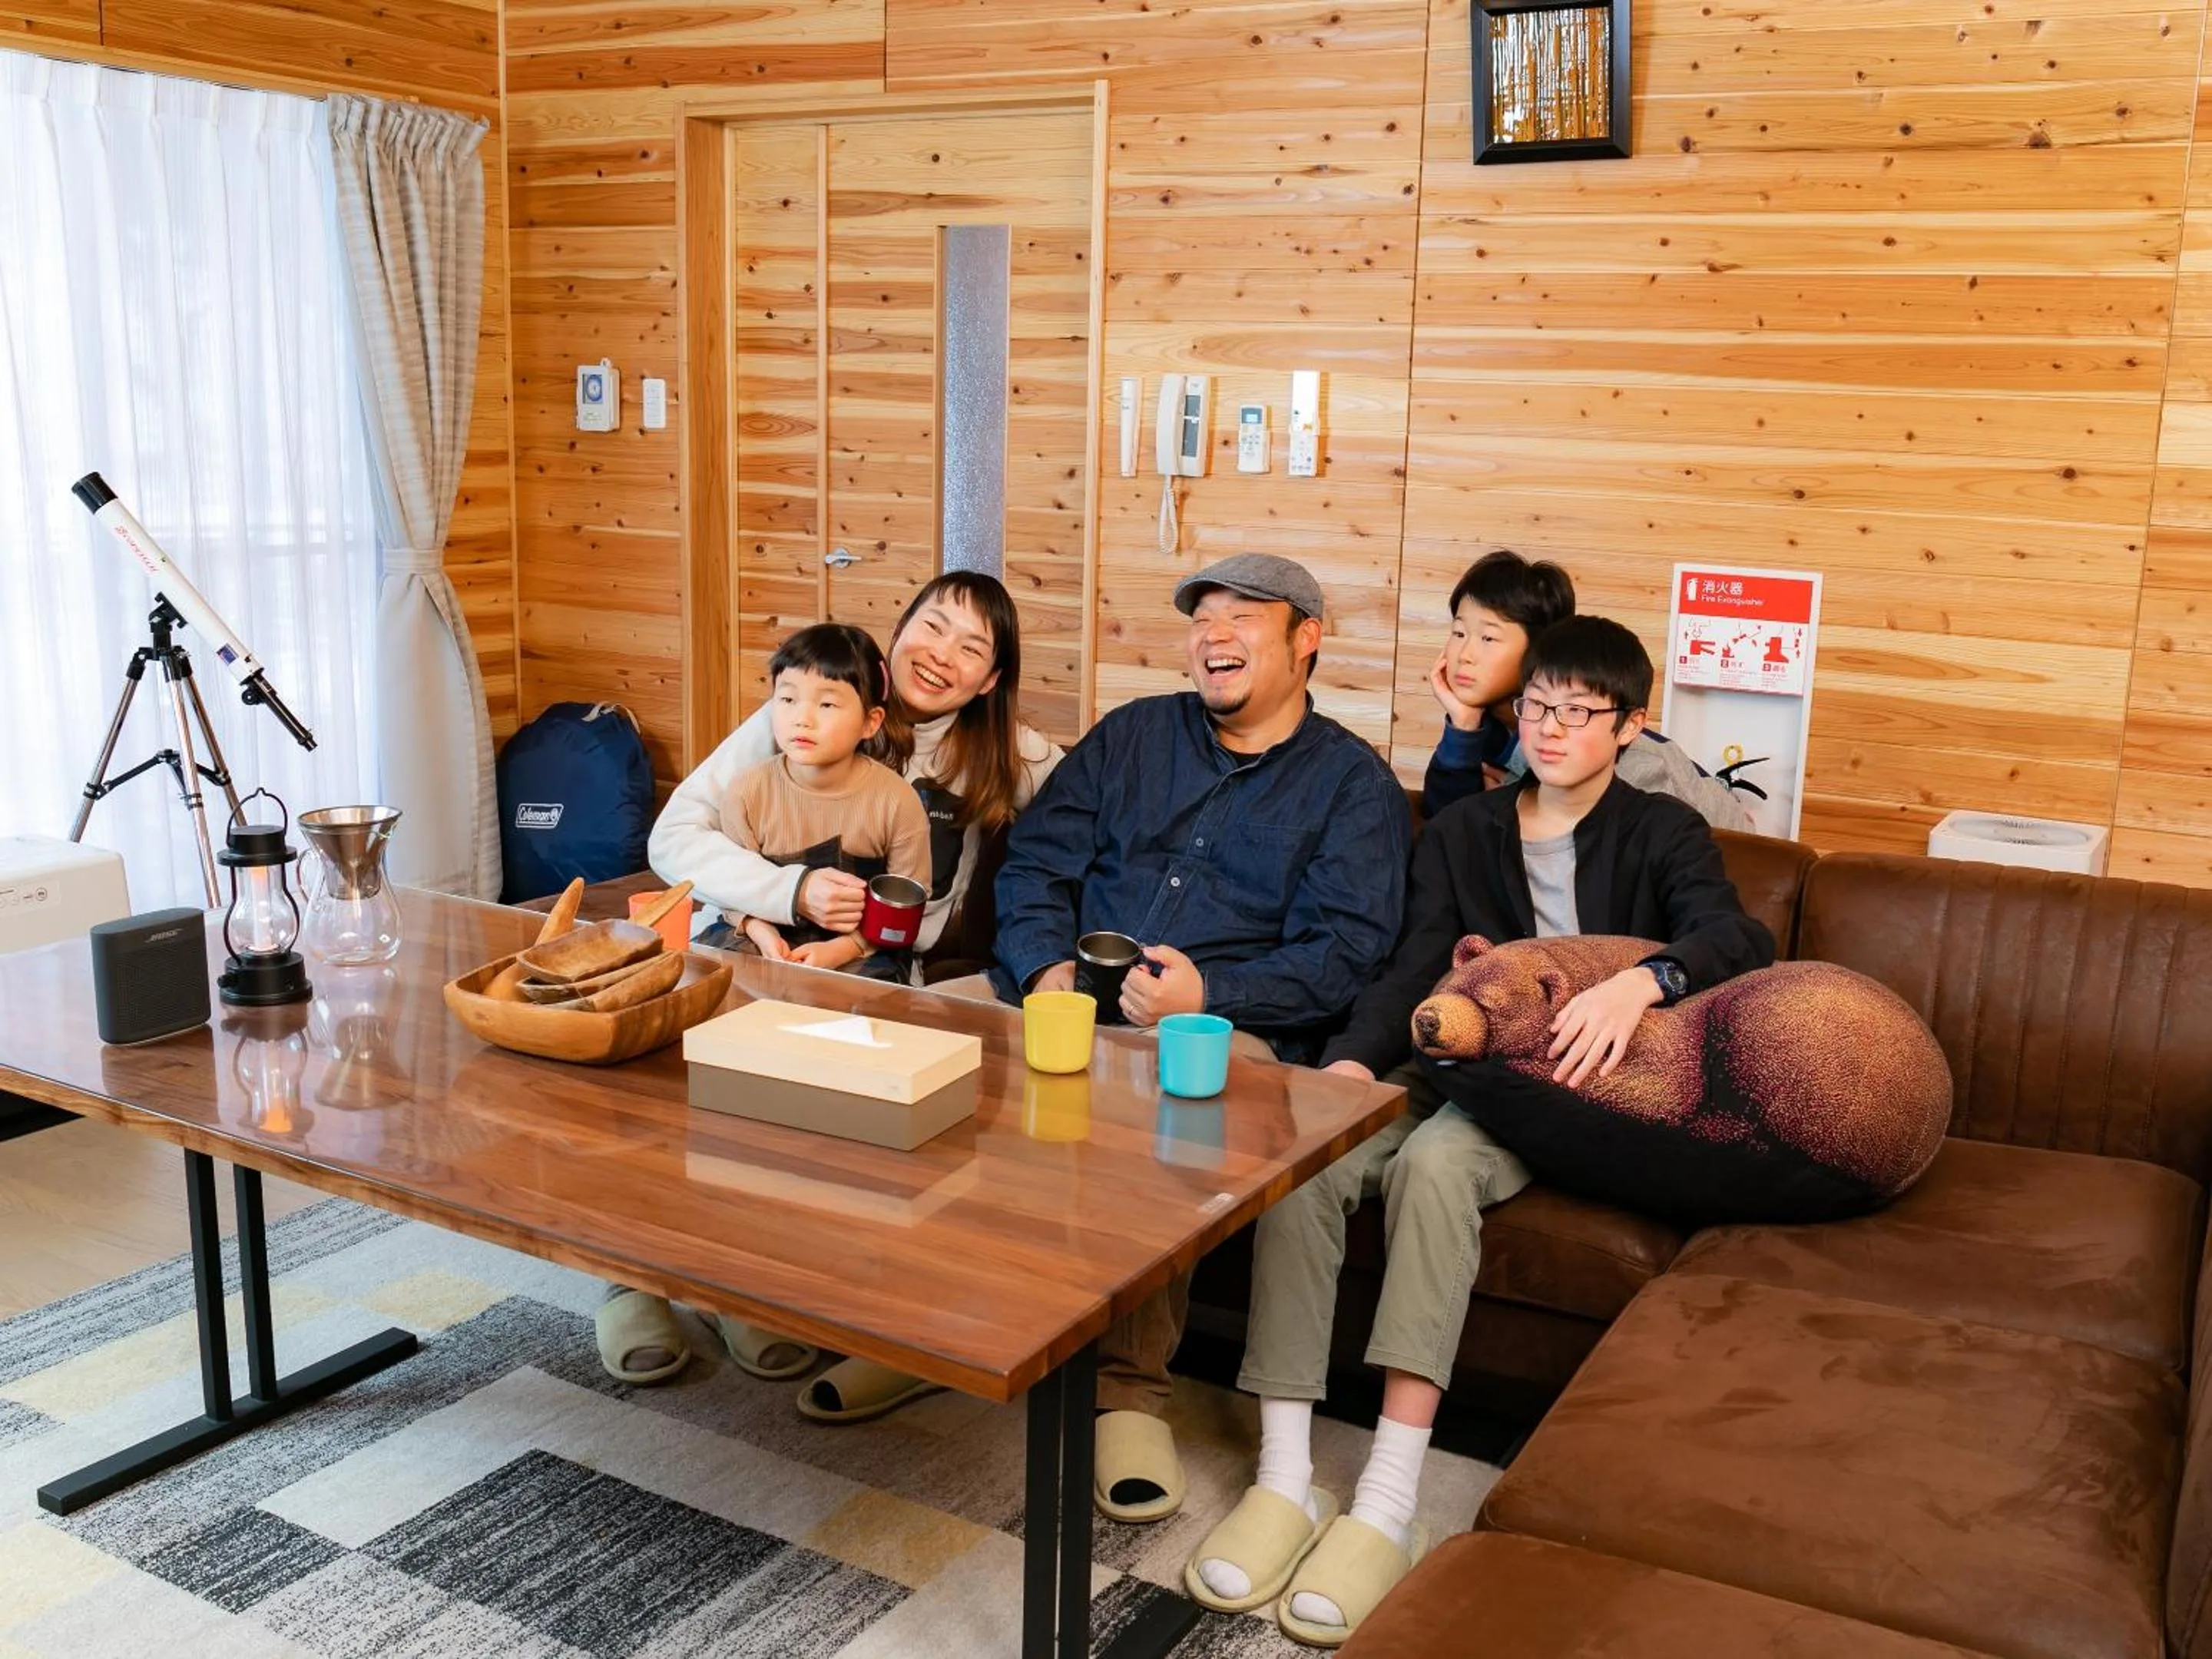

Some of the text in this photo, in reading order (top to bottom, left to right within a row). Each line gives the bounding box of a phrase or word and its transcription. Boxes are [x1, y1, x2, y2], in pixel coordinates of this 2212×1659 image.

[1702, 580, 1743, 595] 消火器
[1717, 596, 1764, 607] Extinguisher
[518, 806, 557, 822] Coleman
